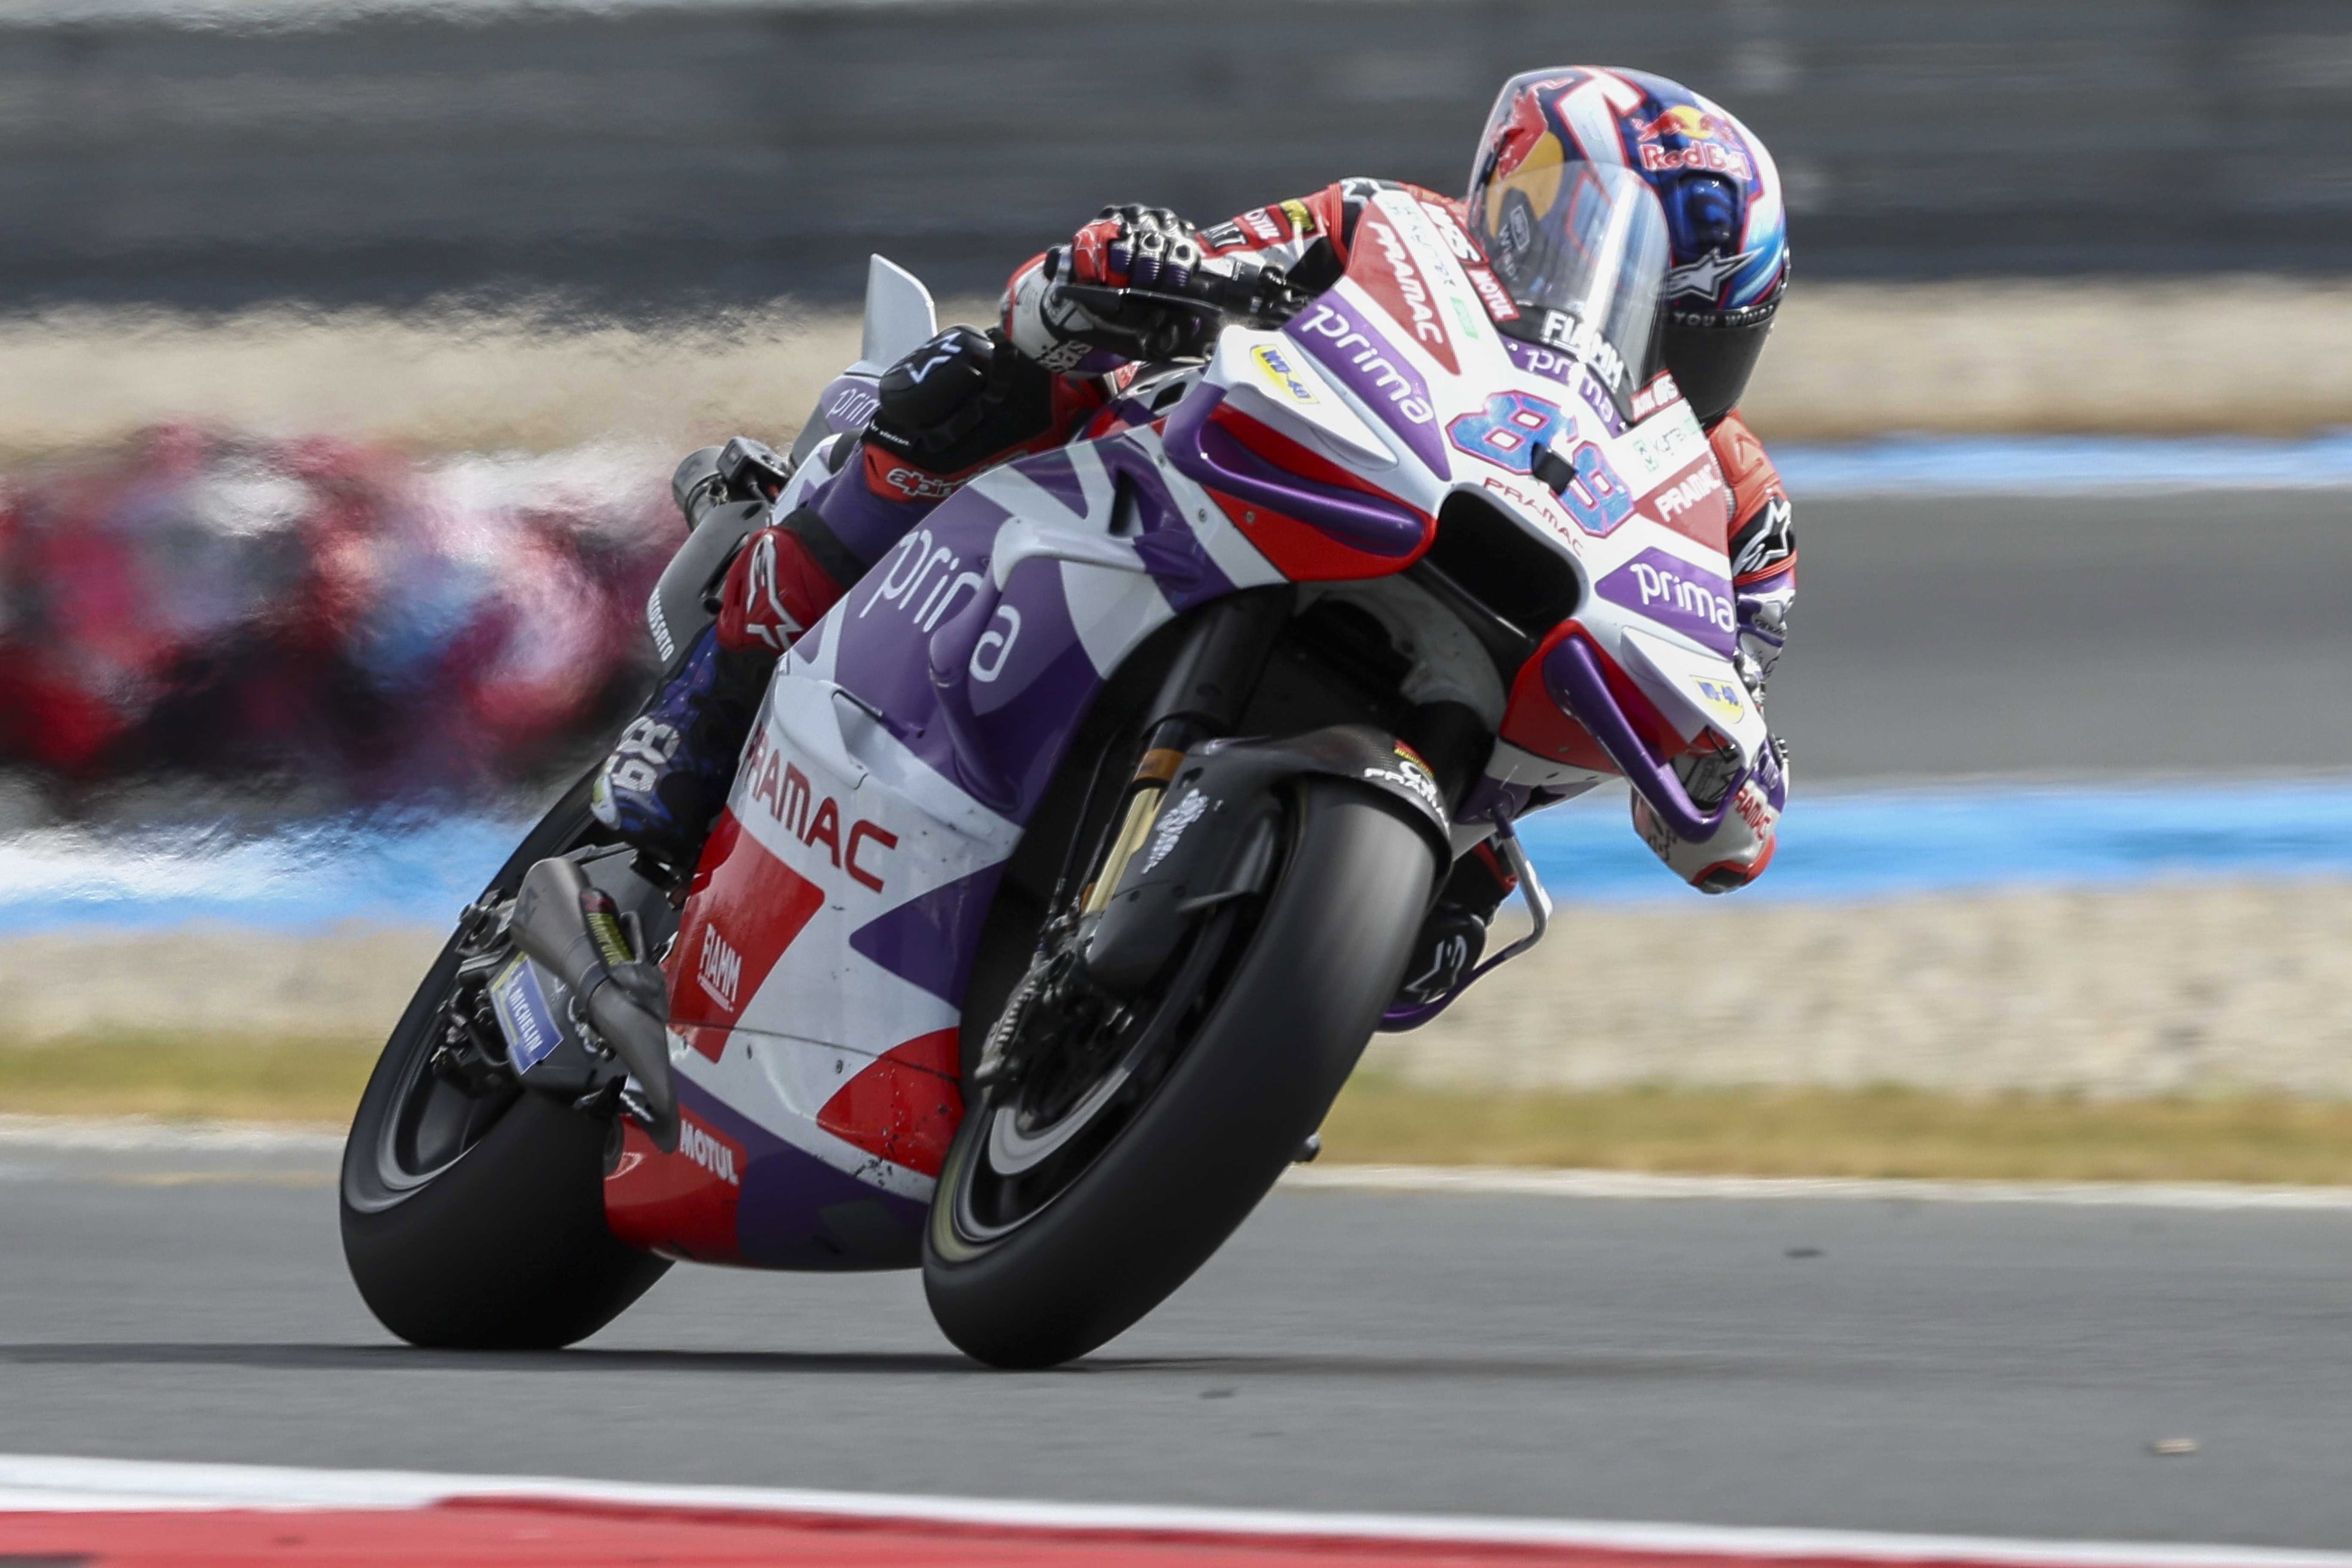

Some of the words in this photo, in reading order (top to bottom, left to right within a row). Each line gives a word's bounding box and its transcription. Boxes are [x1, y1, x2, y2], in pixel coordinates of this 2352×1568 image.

[1639, 140, 1707, 170] Red
[1366, 221, 1443, 344] PRAMAC
[1466, 270, 1514, 319] MOTUL
[1673, 311, 1716, 326] YOU
[1301, 304, 1434, 424] prima
[1445, 390, 1635, 539] 89
[1484, 477, 1584, 557] PRAMAC
[1630, 563, 1735, 633] prima
[699, 923, 742, 1003] FIAMM
[509, 987, 543, 1054] MICHELIN
[680, 1118, 739, 1186] MOTUL
